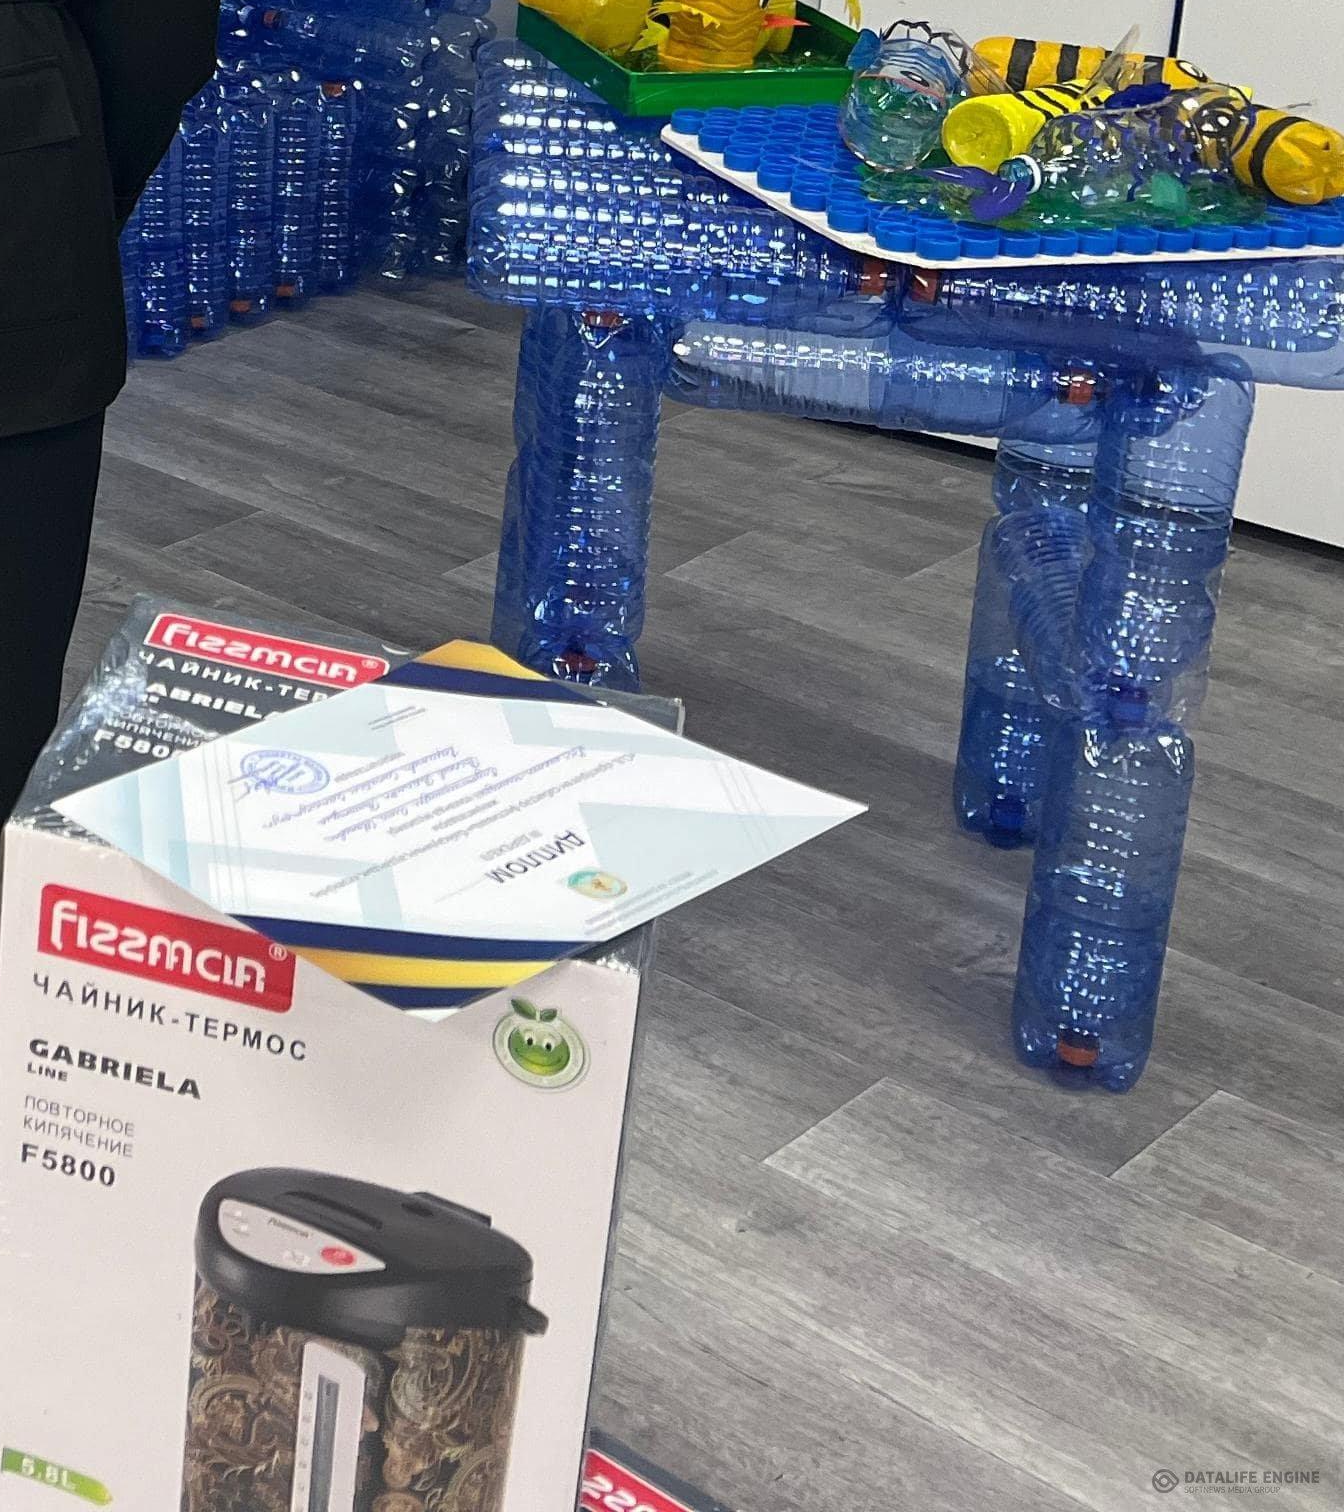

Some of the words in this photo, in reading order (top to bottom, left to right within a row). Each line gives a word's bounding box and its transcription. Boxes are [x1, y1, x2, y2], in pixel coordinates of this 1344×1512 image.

[138, 651, 329, 702] ЧАЙНИК-ТЕР
[142, 682, 270, 719] ABRIEL
[94, 728, 172, 759] F580
[485, 829, 586, 885] ДИПЛОМ
[32, 972, 308, 1061] ЧАЙНИК-ТЕРМОС
[26, 1061, 69, 1082] LINE
[28, 1037, 202, 1100] GABRIELA
[22, 1116, 134, 1159] КИПЯЧЕНИЕ
[23, 1095, 135, 1137] ПОВТОРНОЕ
[20, 1143, 117, 1187] F5800
[20, 1456, 75, 1489] 5.8L
